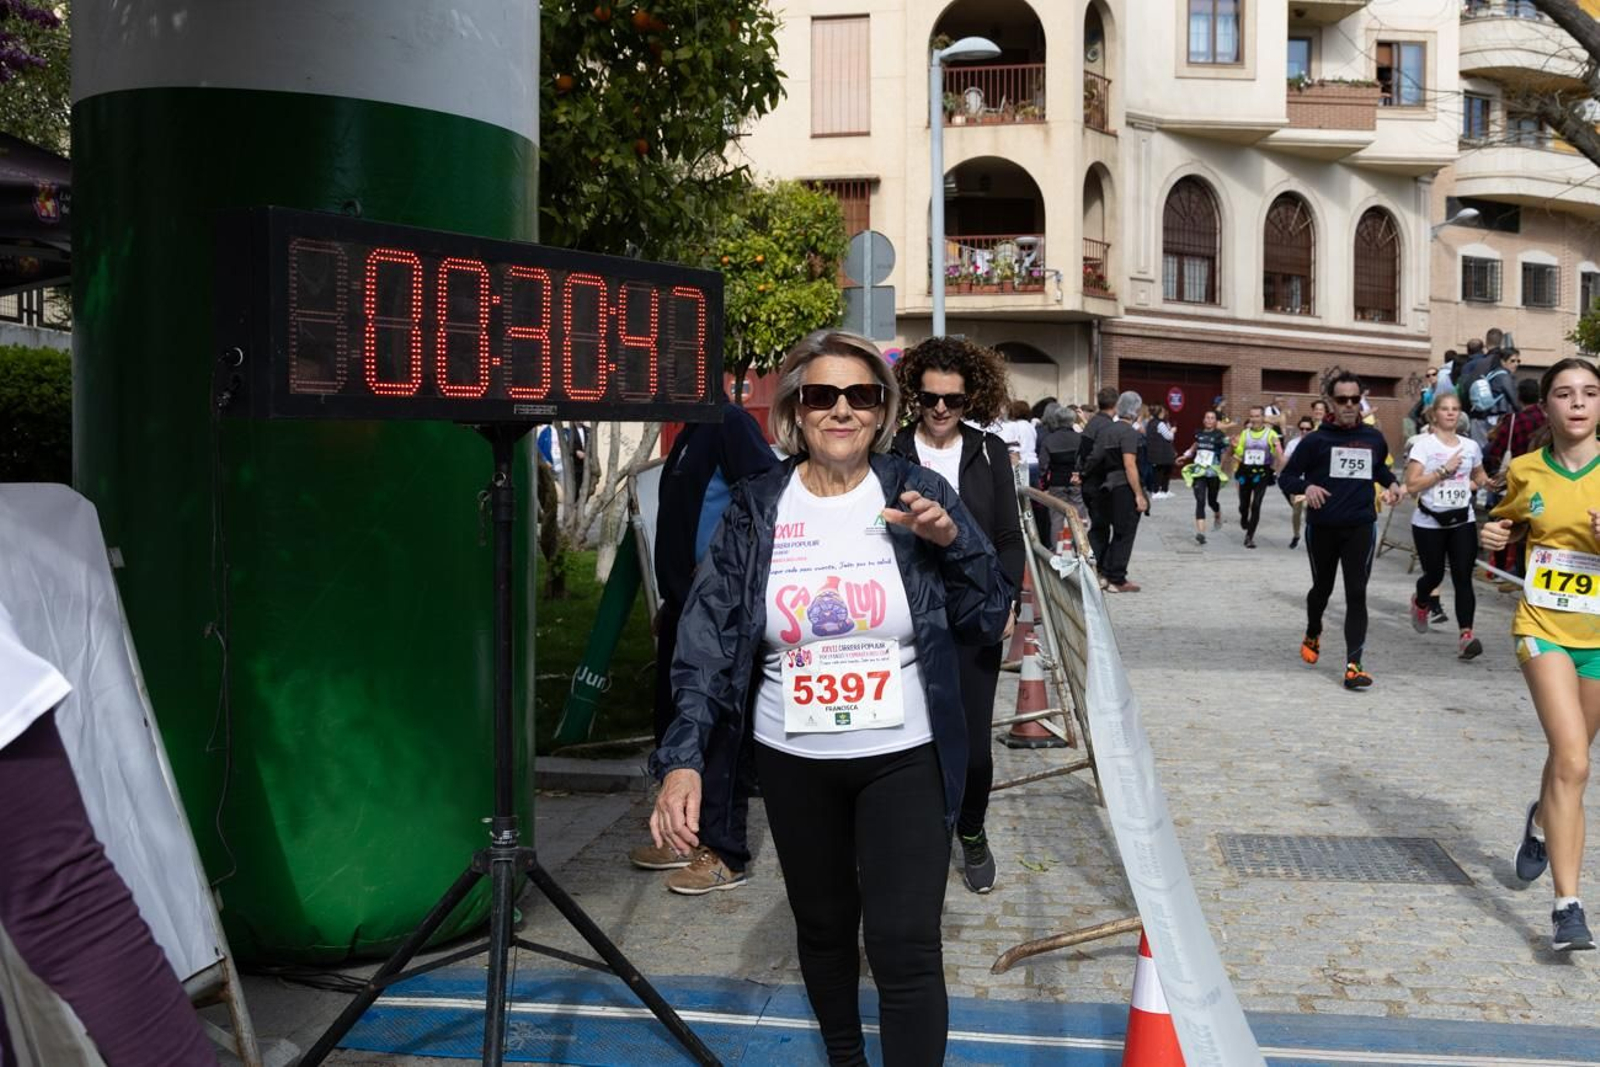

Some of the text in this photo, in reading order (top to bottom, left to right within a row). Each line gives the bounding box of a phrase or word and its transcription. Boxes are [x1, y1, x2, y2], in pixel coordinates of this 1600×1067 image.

[364, 247, 706, 402] 00:30:47
[1340, 458, 1365, 470] 755
[1438, 490, 1466, 499] 1190
[1541, 569, 1592, 594] 179
[793, 670, 890, 705] 5397
[825, 704, 859, 712] FRANCISCA
